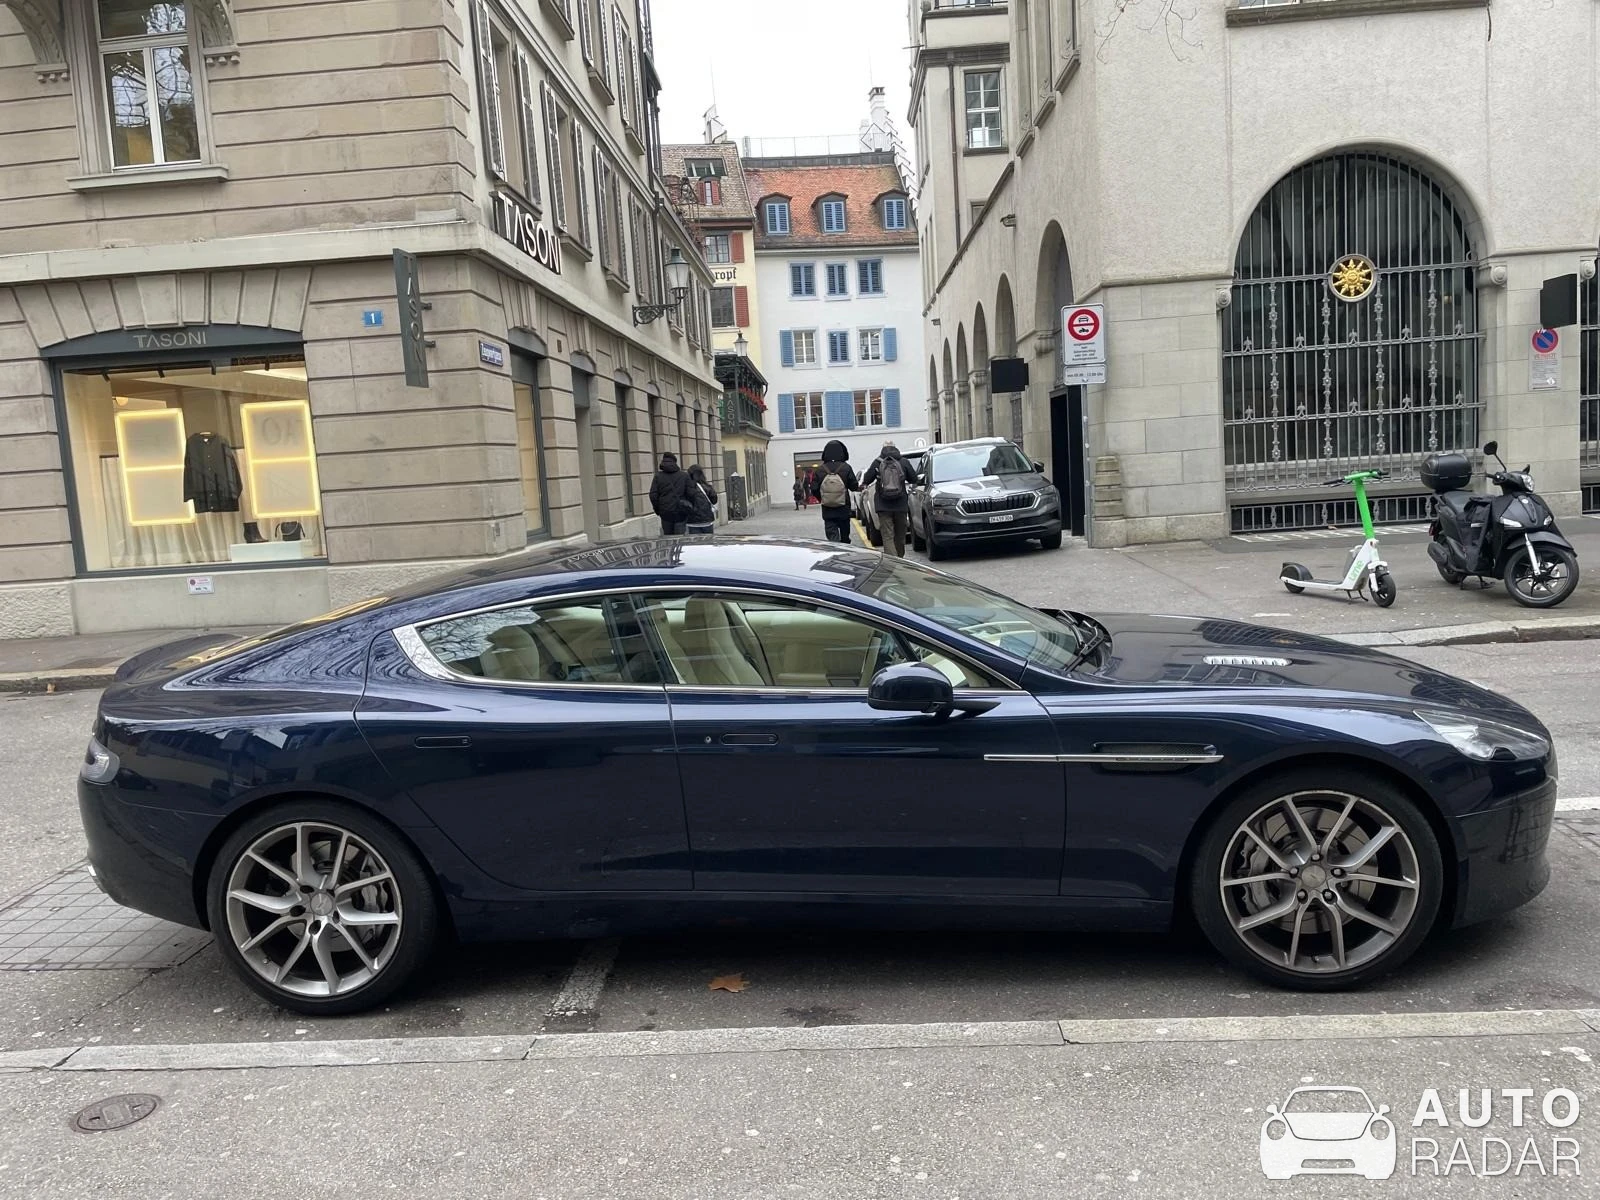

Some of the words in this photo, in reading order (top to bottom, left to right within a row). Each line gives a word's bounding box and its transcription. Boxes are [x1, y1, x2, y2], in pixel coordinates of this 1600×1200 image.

[497, 190, 562, 275] TASONI
[715, 267, 737, 281] ropf
[132, 331, 207, 349] TASONI
[726, 391, 735, 433] TASONI
